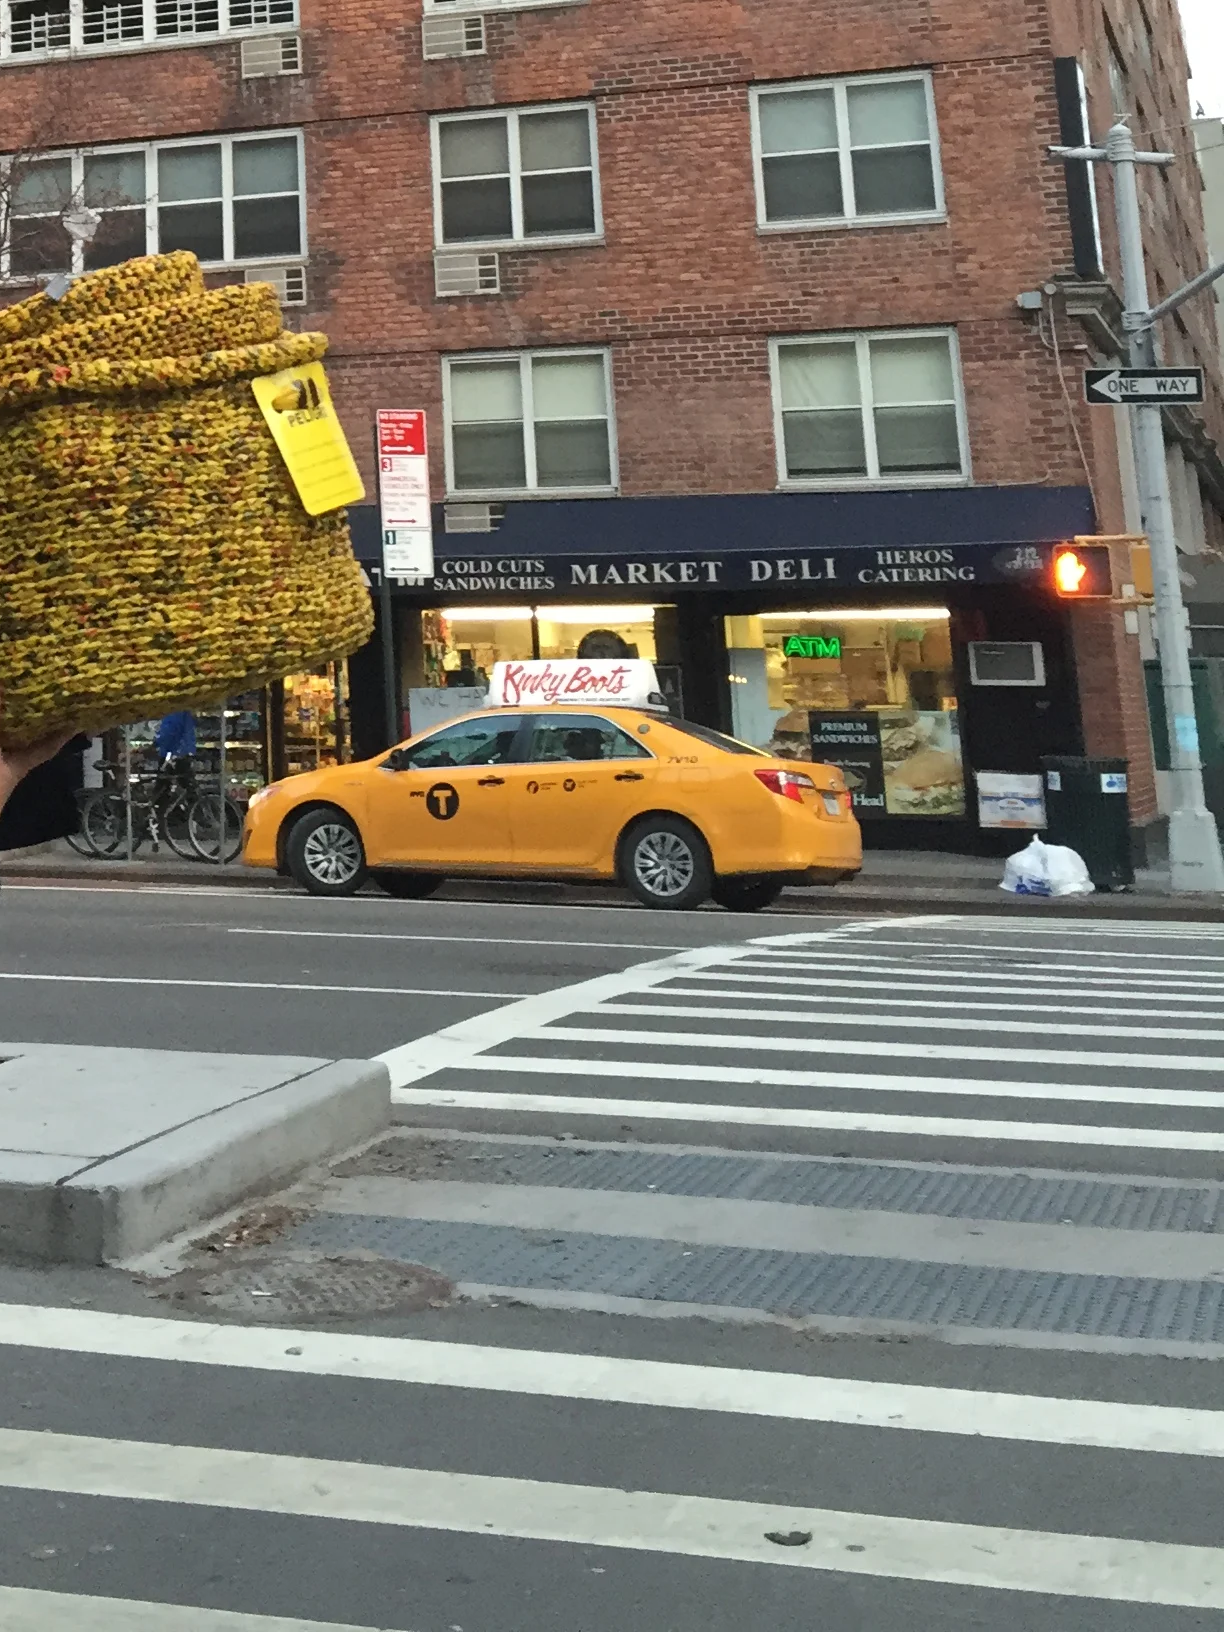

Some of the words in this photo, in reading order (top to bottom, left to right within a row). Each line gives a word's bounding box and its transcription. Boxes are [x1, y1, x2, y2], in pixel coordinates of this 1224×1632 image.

[1107, 379, 1139, 393] ONE
[1155, 379, 1189, 392] WAY
[381, 457, 391, 472] 3
[876, 548, 954, 565] HEROS
[442, 560, 493, 574] COLD
[497, 560, 545, 573] CUTS
[570, 561, 723, 585] MARKET
[749, 558, 837, 582] DELI
[858, 566, 975, 584] CATERING
[433, 576, 555, 591] SANDWICHES
[785, 635, 841, 658] ATM
[502, 663, 567, 704] Kinky
[564, 665, 632, 695] Boots
[820, 722, 868, 732] PREMIUM
[812, 734, 878, 744] SANDWICHES
[433, 790, 453, 816] T
[853, 792, 884, 807] Head
